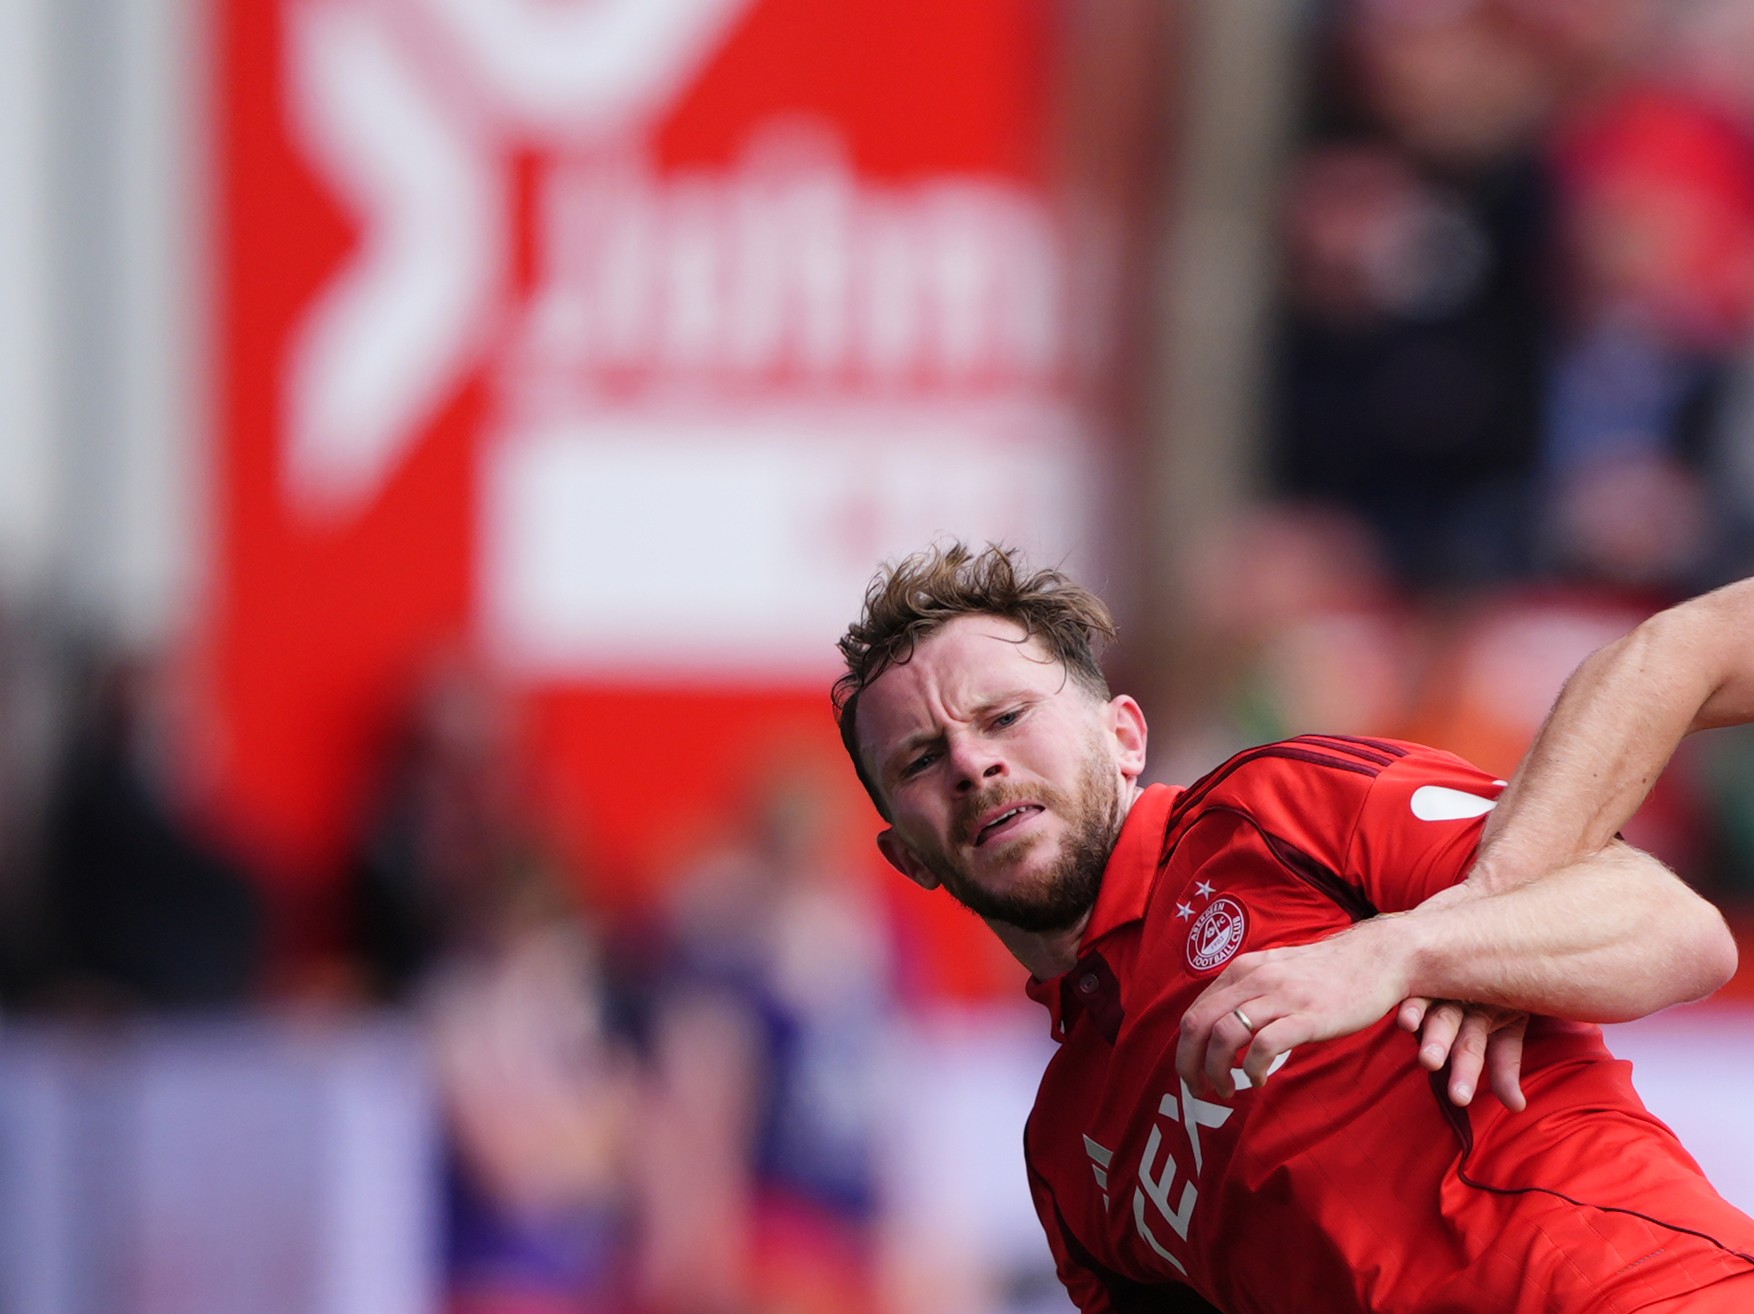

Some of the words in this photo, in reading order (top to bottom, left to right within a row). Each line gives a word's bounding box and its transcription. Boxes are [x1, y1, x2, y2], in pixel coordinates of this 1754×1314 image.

[1192, 943, 1236, 967] FOOTBALL
[1231, 915, 1242, 943] CLUB
[1132, 1048, 1293, 1277] TEX
